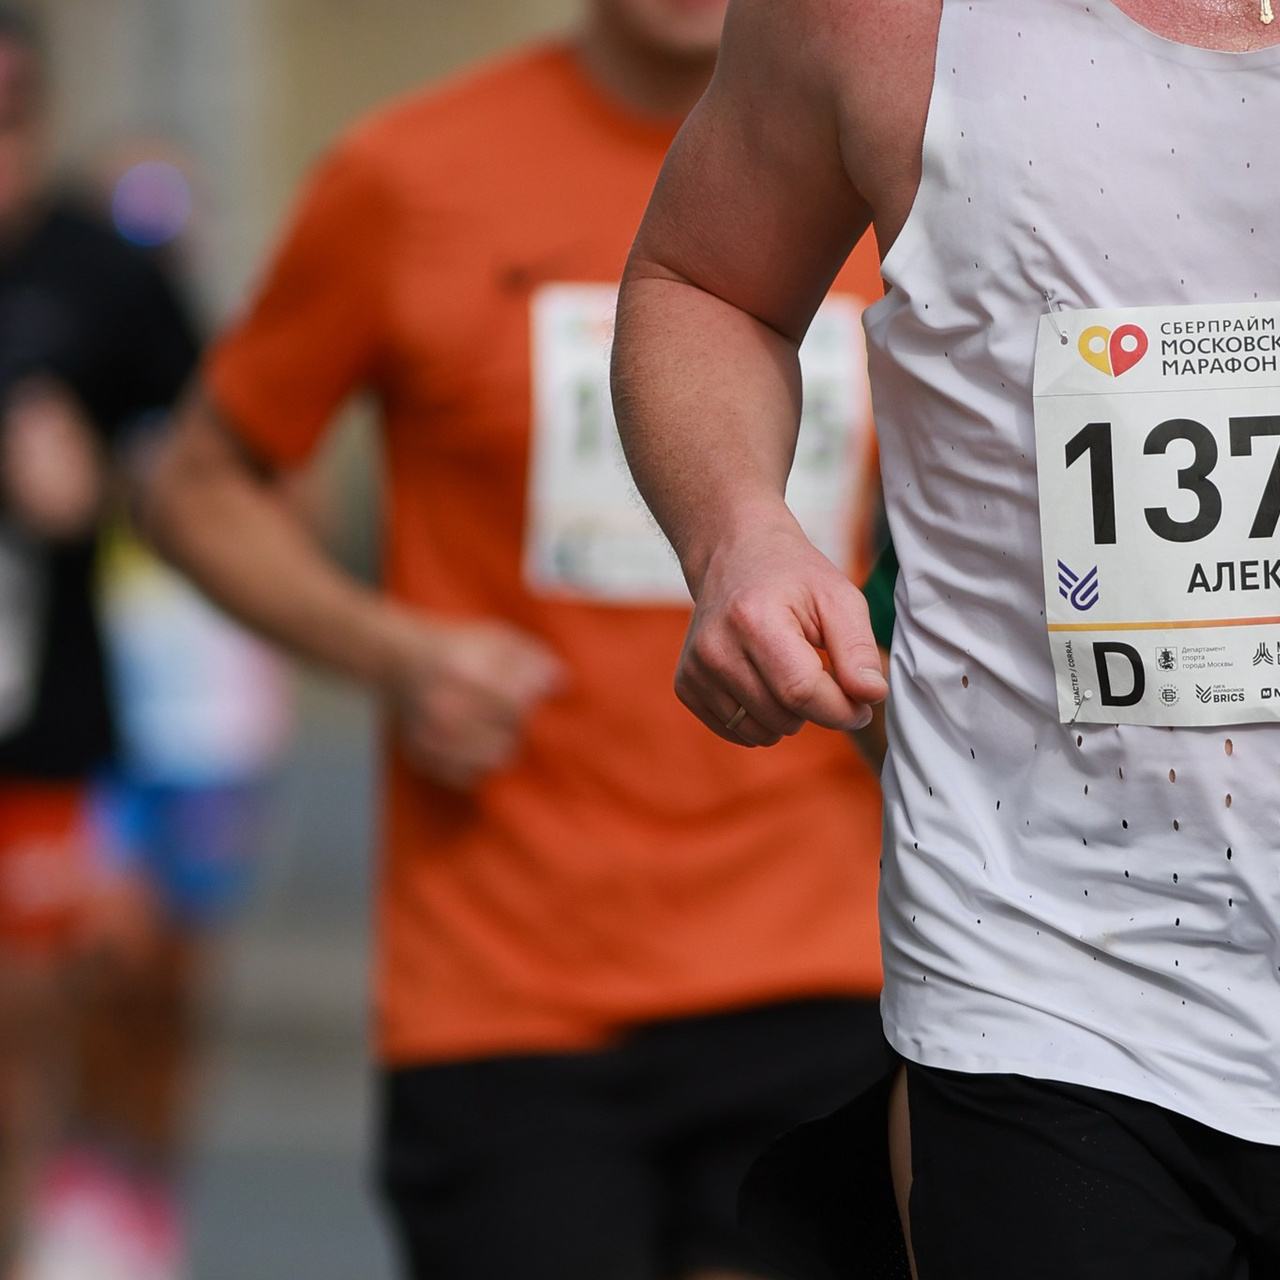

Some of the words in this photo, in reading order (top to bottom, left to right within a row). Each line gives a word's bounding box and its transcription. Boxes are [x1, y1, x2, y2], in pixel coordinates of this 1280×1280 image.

[1160, 316, 1275, 335] СБЕРПРАЙМ
[1162, 355, 1278, 376] МАРАФОН
[1181, 645, 1226, 654] Департамент
[1182, 654, 1206, 662] спорта
[1182, 661, 1206, 670] города
[1207, 660, 1234, 668] Москвы
[1093, 642, 1145, 707] D
[1213, 693, 1245, 702] BRICS
